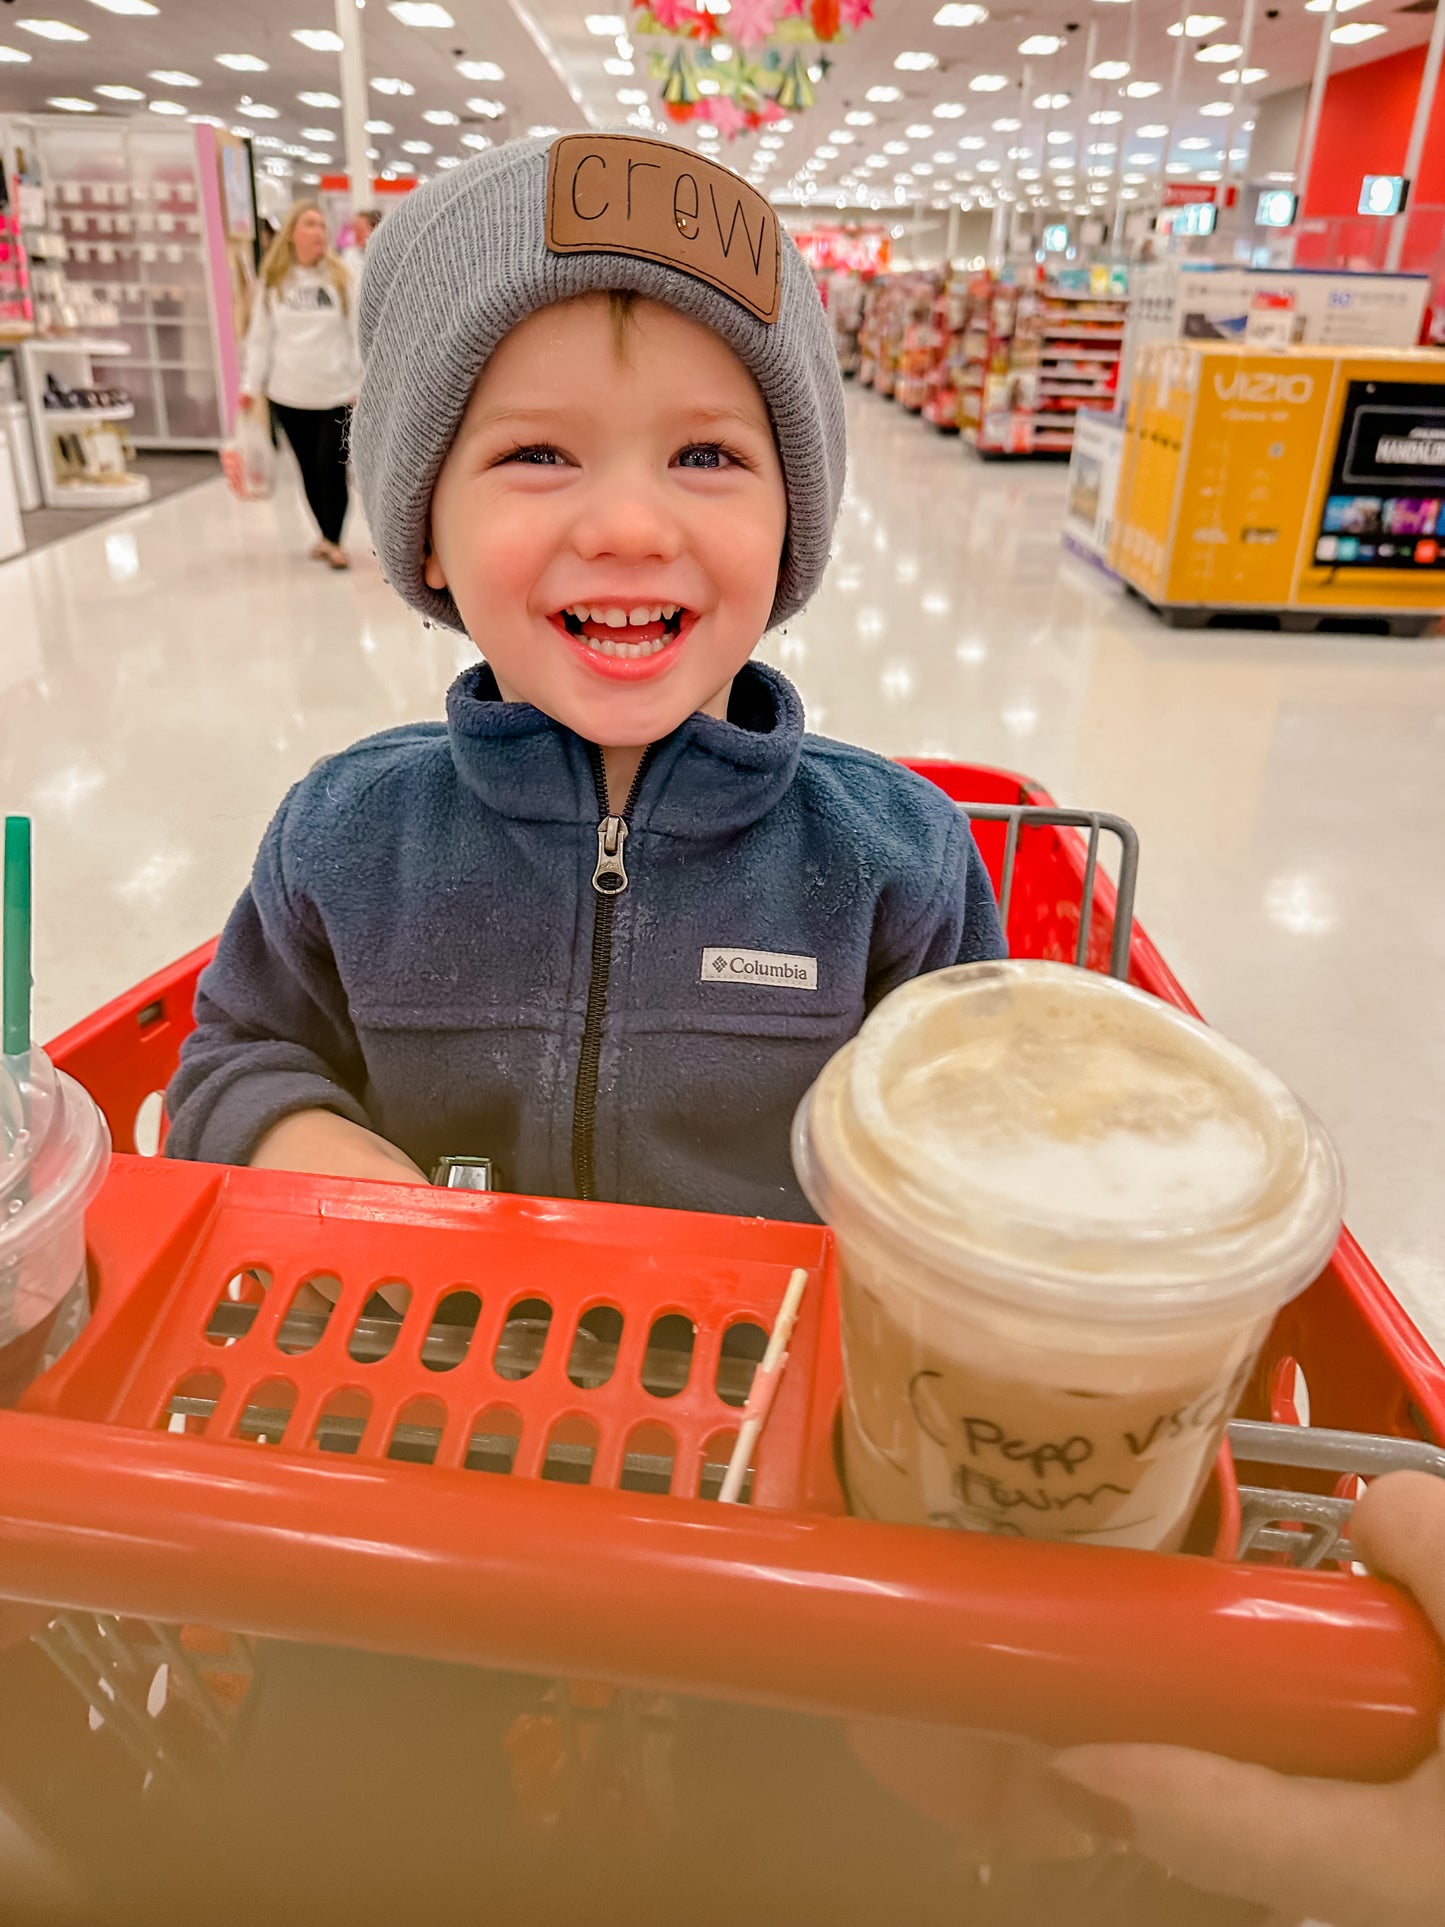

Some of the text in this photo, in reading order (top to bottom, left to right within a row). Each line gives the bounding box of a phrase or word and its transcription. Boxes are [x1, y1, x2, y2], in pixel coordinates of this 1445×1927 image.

[571, 154, 765, 276] crew
[1214, 371, 1314, 403] VIZIO
[729, 957, 807, 980] Columbia
[962, 1417, 1093, 1479] Pepp
